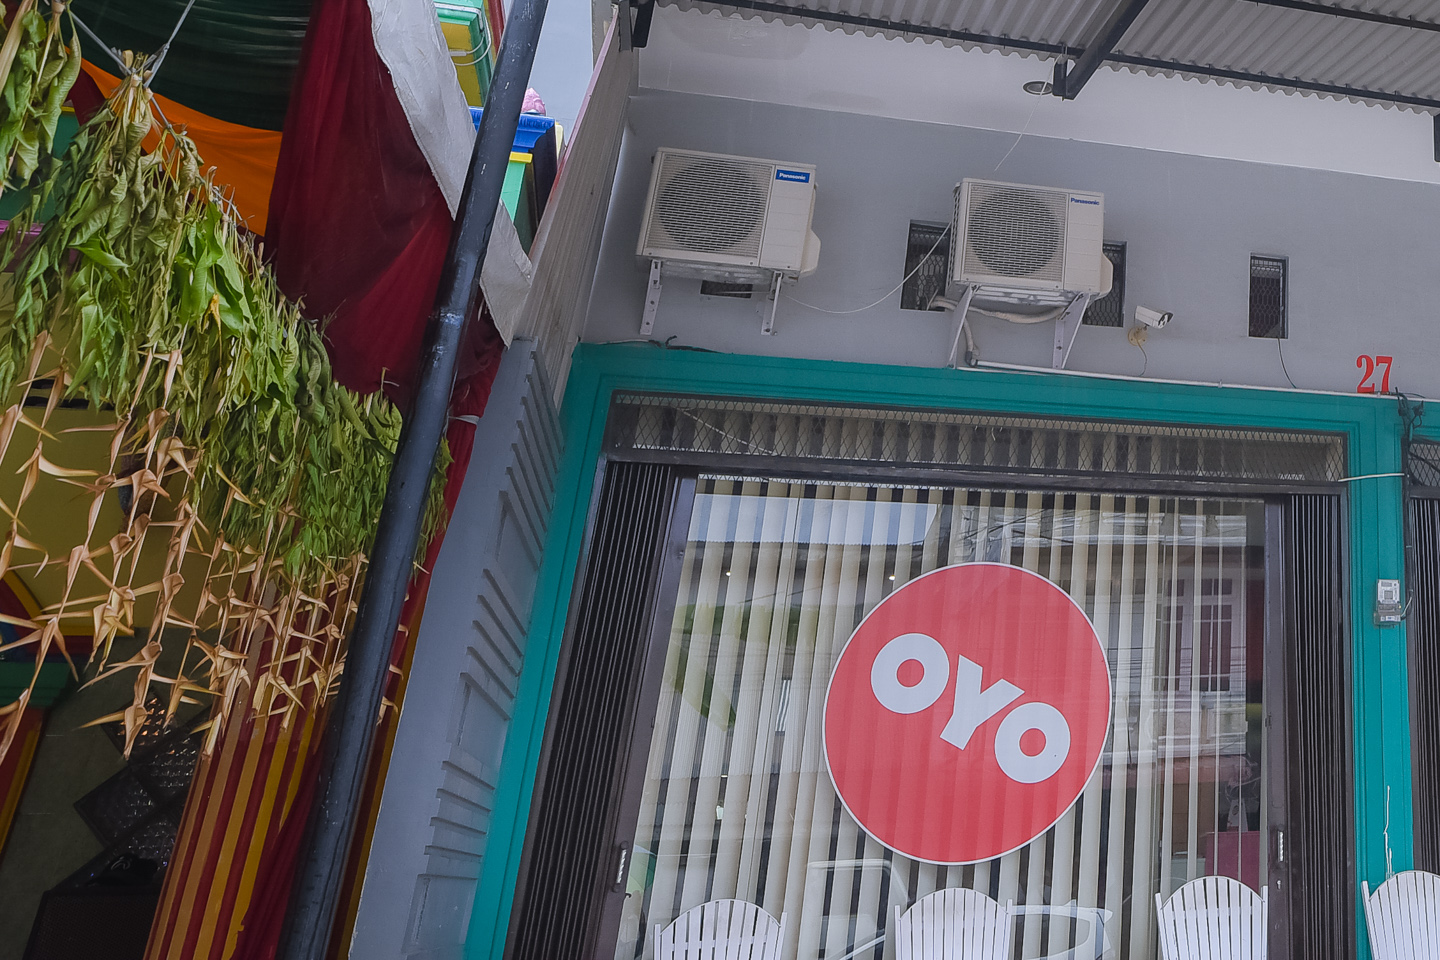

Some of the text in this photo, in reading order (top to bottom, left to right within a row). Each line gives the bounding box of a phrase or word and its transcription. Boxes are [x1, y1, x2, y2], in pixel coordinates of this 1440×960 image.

[779, 172, 806, 180] Panasonic
[1071, 197, 1099, 205] Panasonic
[1356, 354, 1393, 395] 27
[871, 633, 1071, 784] OYO
